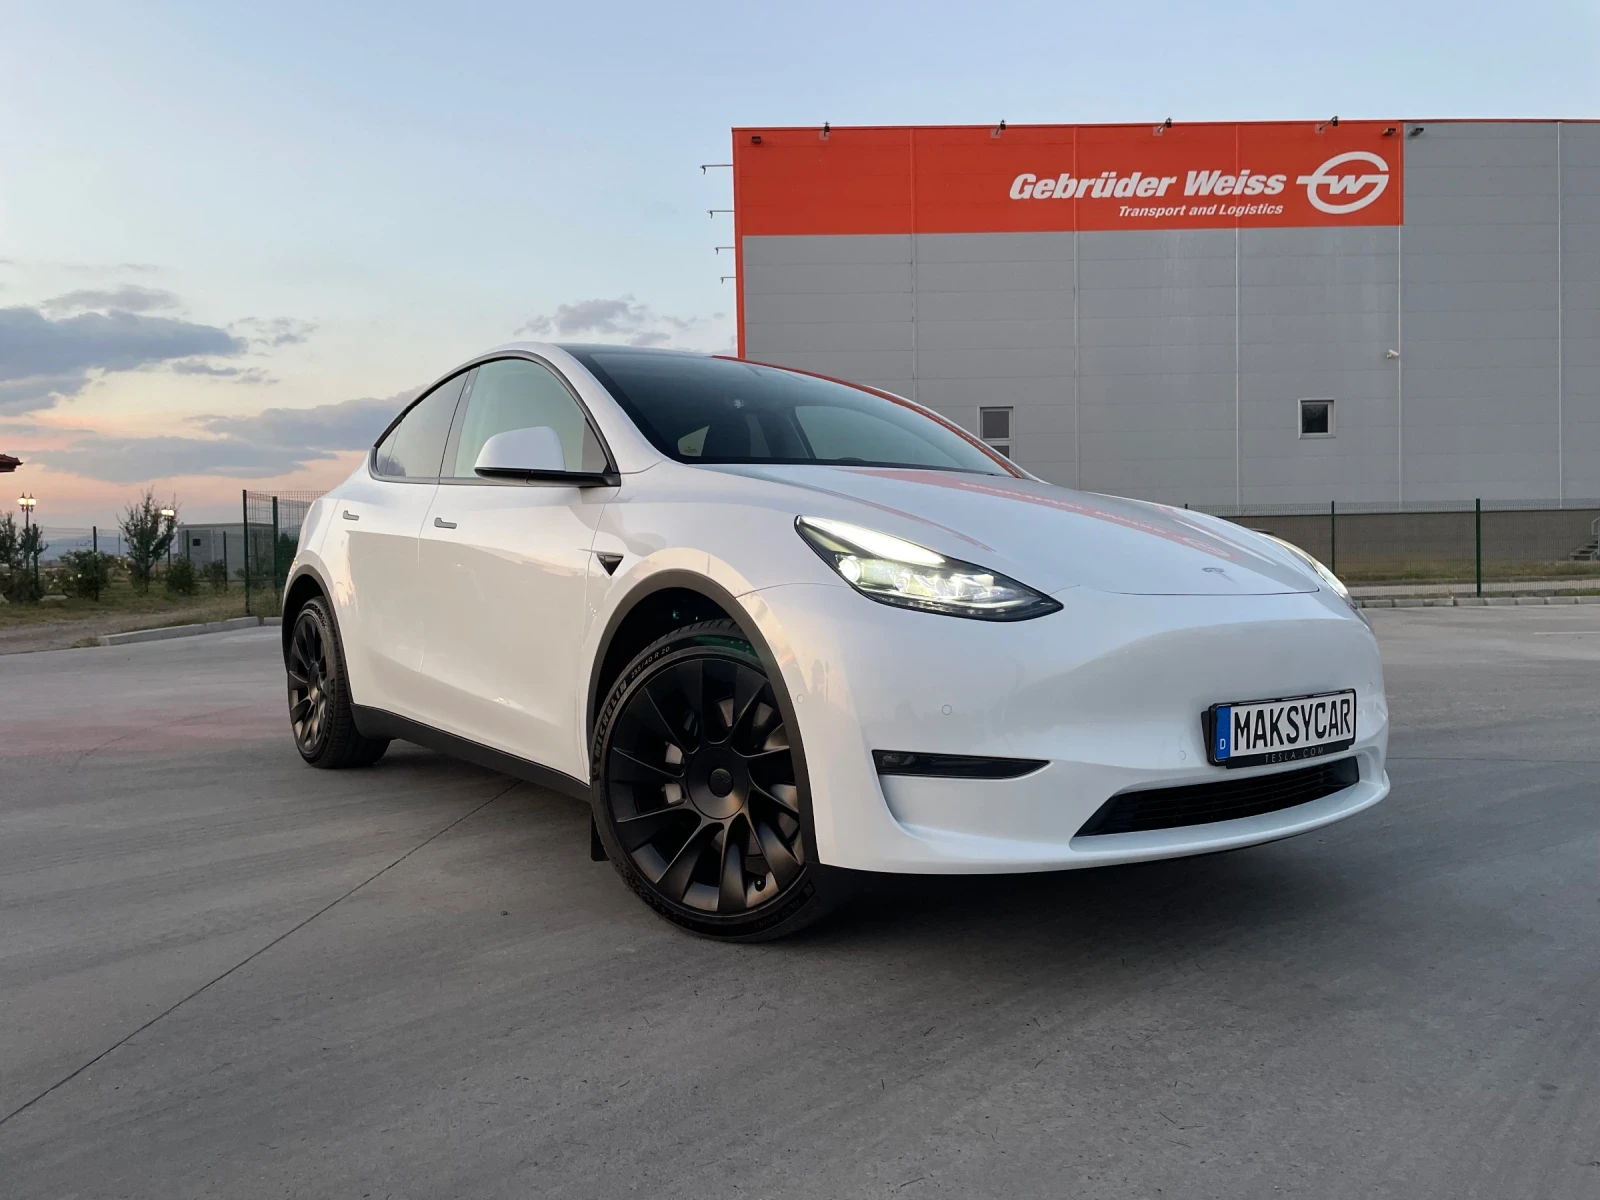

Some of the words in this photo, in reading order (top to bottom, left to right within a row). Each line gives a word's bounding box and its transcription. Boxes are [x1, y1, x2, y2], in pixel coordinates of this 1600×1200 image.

[1009, 171, 1177, 200] Gebrüder
[1184, 169, 1287, 197] Weiss
[1119, 205, 1186, 218] Transport
[1189, 203, 1219, 216] and
[1219, 203, 1284, 217] Logistics
[595, 680, 627, 758] MICHELIN
[1219, 738, 1226, 750] D
[1234, 698, 1351, 751] MAKSYCAR
[1264, 747, 1324, 763] TESLA.COM
